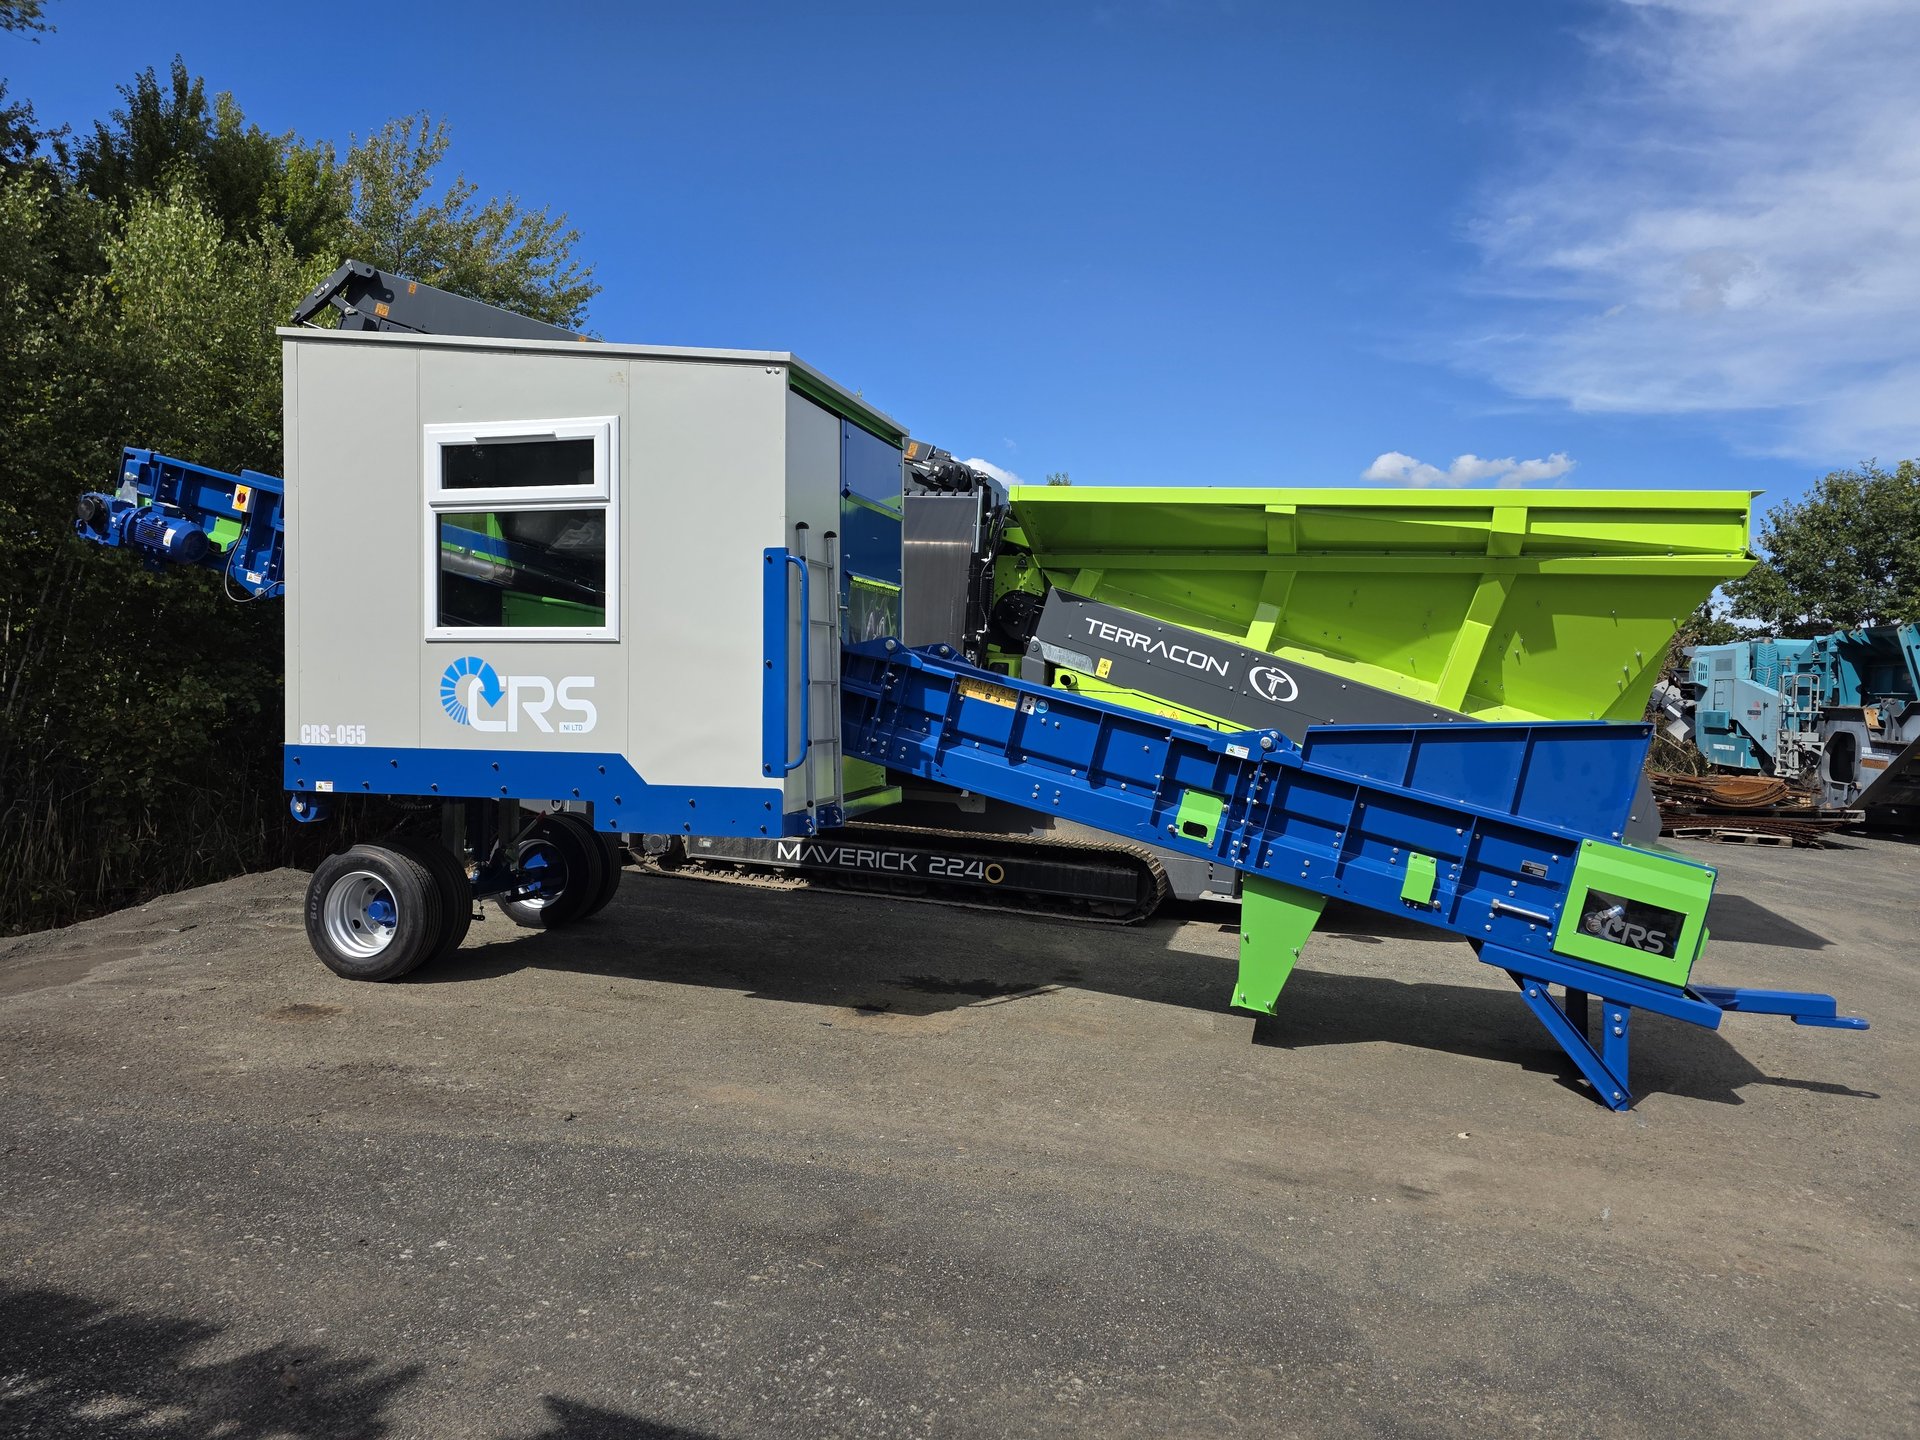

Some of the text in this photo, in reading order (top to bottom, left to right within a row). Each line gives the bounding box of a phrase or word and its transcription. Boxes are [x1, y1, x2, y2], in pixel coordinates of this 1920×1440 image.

[1085, 617, 1230, 677] TERRACON
[468, 675, 598, 733] CRS
[300, 724, 366, 745] CRS-055
[777, 841, 1005, 884] MAVERICK 2240
[1605, 919, 1667, 954] CRS
